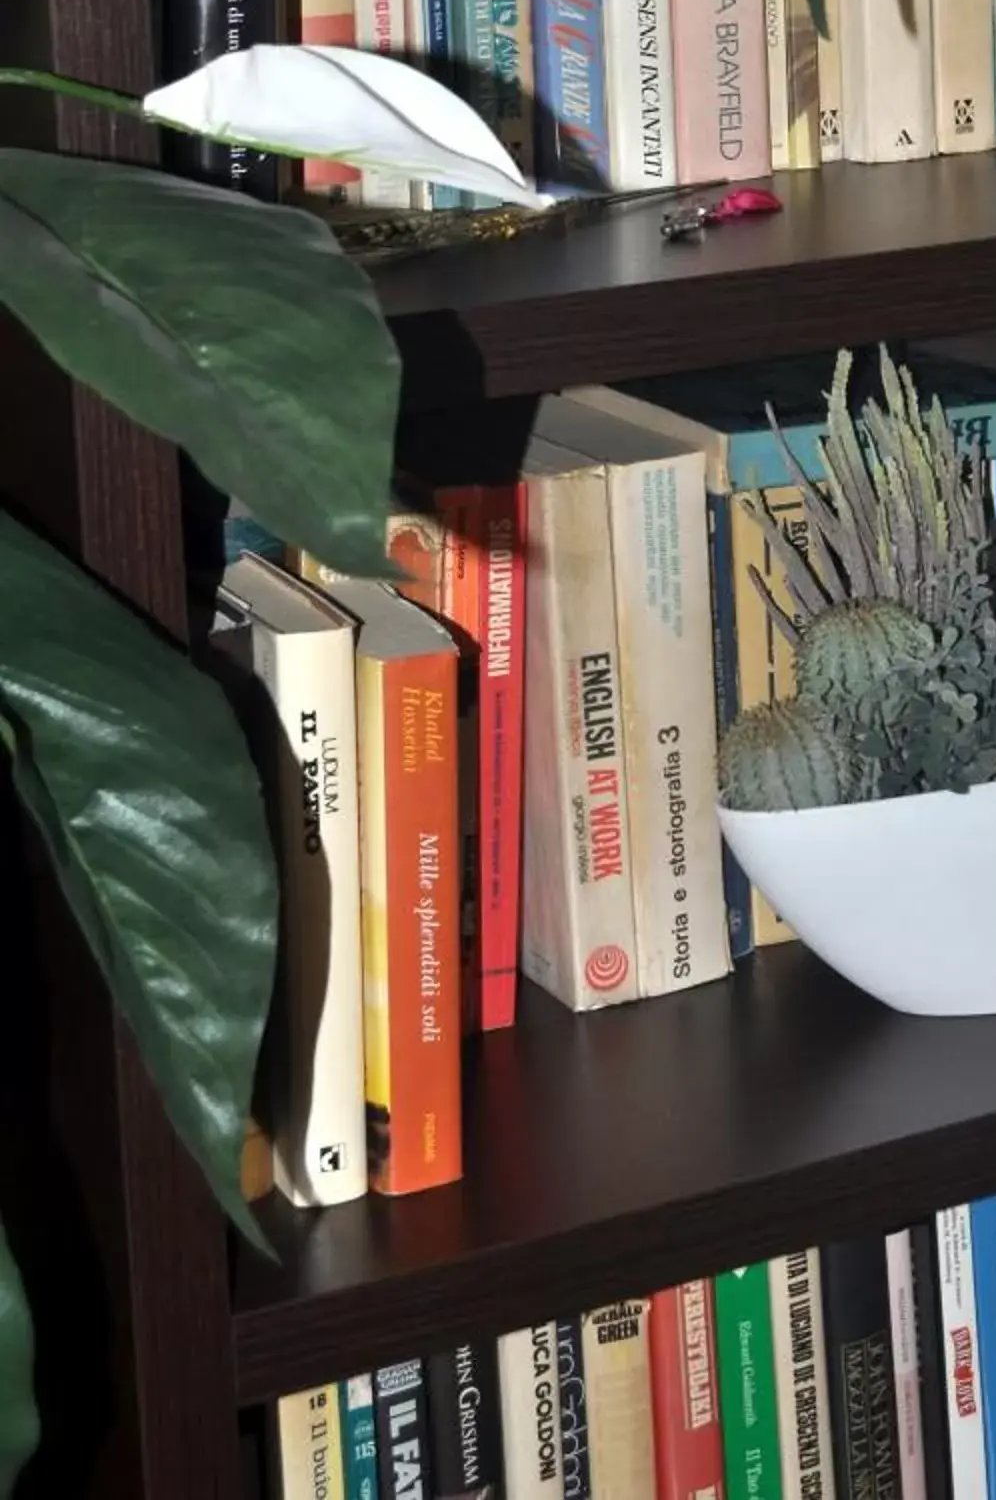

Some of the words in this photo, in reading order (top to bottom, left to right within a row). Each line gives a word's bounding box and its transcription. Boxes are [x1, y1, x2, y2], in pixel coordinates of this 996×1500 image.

[225, 6, 243, 24] di
[639, 64, 664, 179] INCANTATI
[715, 22, 743, 162] BRAYFIELD
[487, 519, 514, 680] INFORMATIONS
[301, 706, 317, 740] IL
[400, 682, 423, 772] Hosseini
[423, 688, 444, 760] Khaled
[579, 651, 616, 760] ENGLISH
[659, 725, 681, 746] 3
[301, 755, 322, 855] PATTO
[322, 733, 338, 814] LUDLUM
[589, 766, 619, 794] AT
[591, 800, 623, 882] WORK
[662, 753, 688, 879] storiografia
[417, 830, 441, 889] Mille
[674, 889, 687, 904] e
[412, 894, 441, 995] splendidi
[670, 913, 692, 981] Storia
[419, 1001, 441, 1040] soli
[788, 1281, 809, 1297] DI
[531, 1322, 552, 1377] LUCA
[596, 1316, 640, 1345] GREEN
[683, 1280, 713, 1428] PERESTROJKA
[789, 1300, 813, 1363] LUCIANO
[793, 1364, 815, 1384] DE
[388, 1398, 417, 1438] IL
[458, 1385, 480, 1484] GRISHAM
[534, 1381, 557, 1482] GOLDONI
[794, 1385, 819, 1469] CRESCENZO
[745, 1447, 760, 1460] Il
[745, 1462, 761, 1493] Tao
